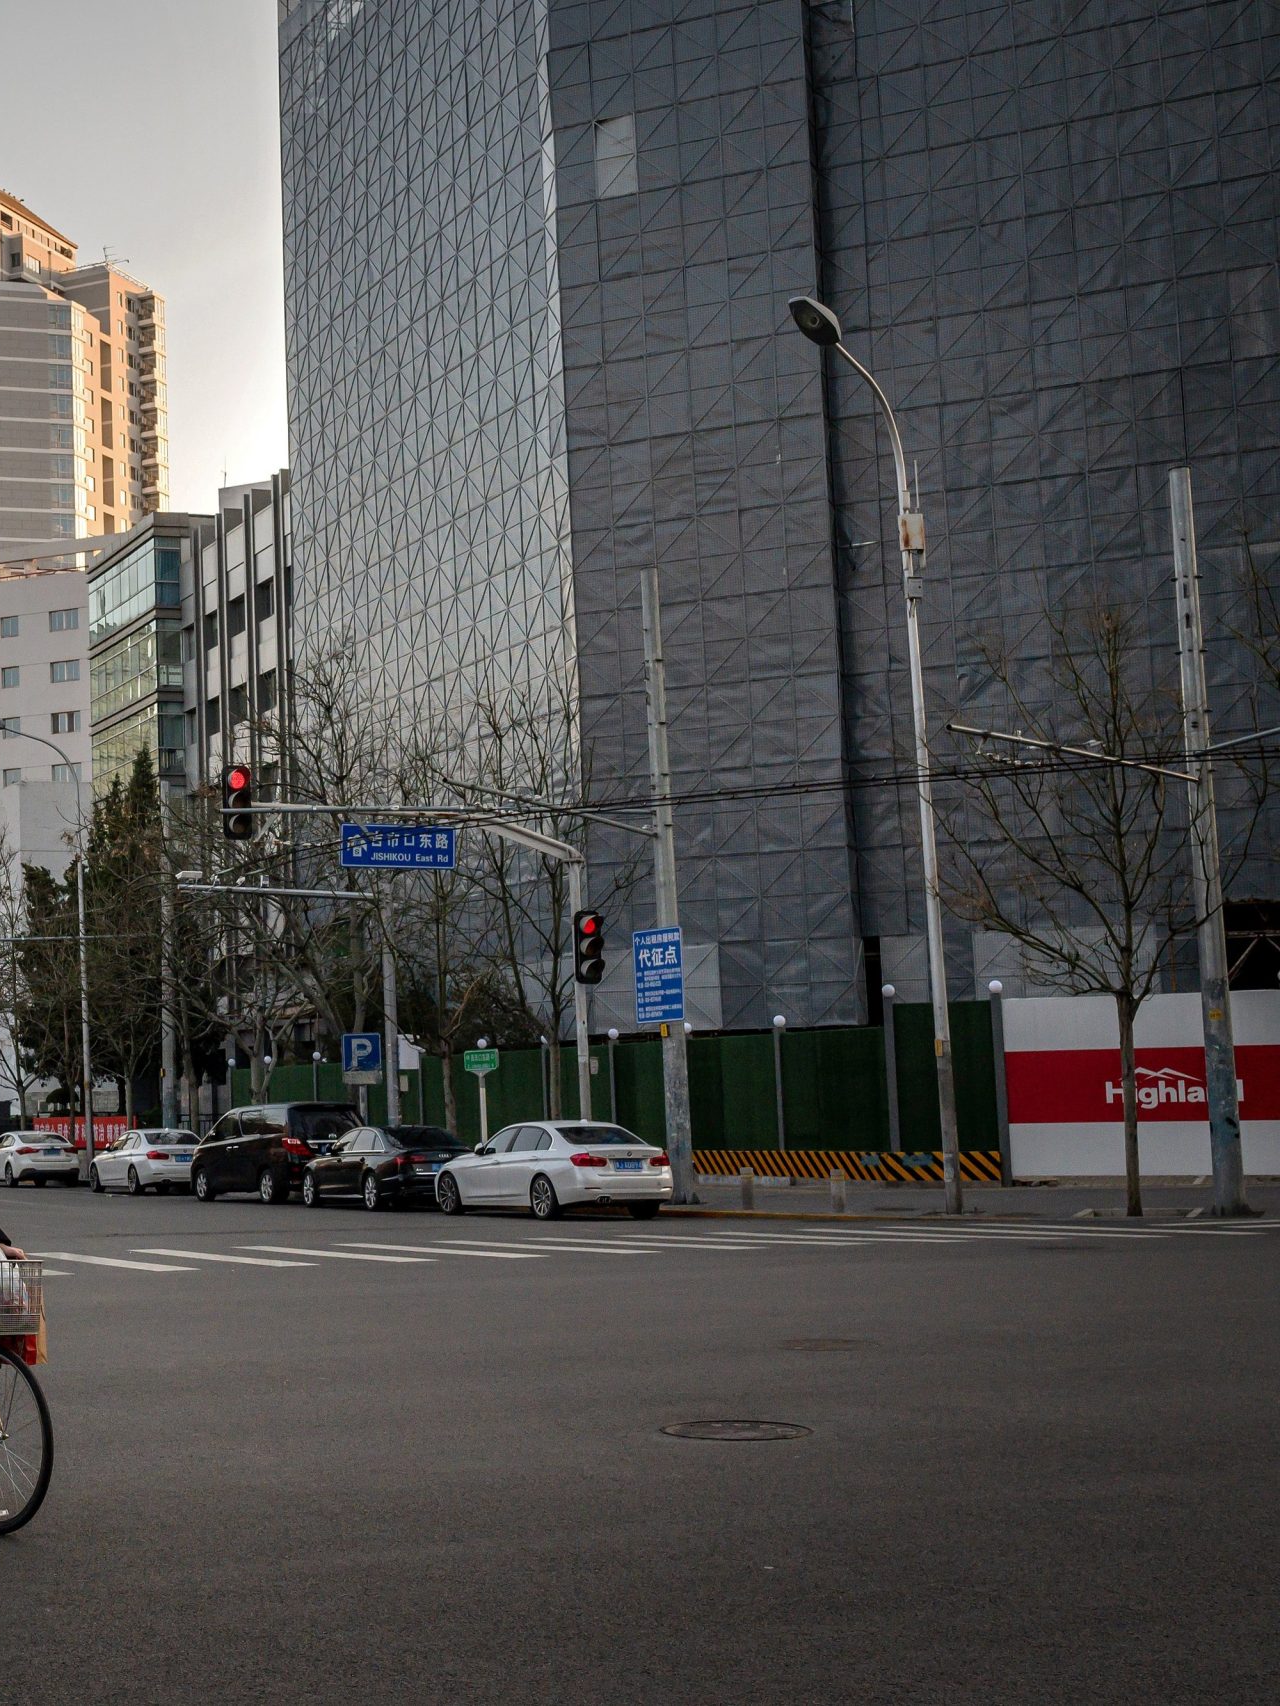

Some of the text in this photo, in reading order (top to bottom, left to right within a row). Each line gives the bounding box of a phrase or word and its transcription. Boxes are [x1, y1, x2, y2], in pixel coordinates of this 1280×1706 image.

[370, 852, 449, 863] JISHIKOU East Rd
[638, 945, 677, 968] 代征点
[351, 1038, 373, 1067] P
[1105, 1079, 1245, 1110] Hghla
